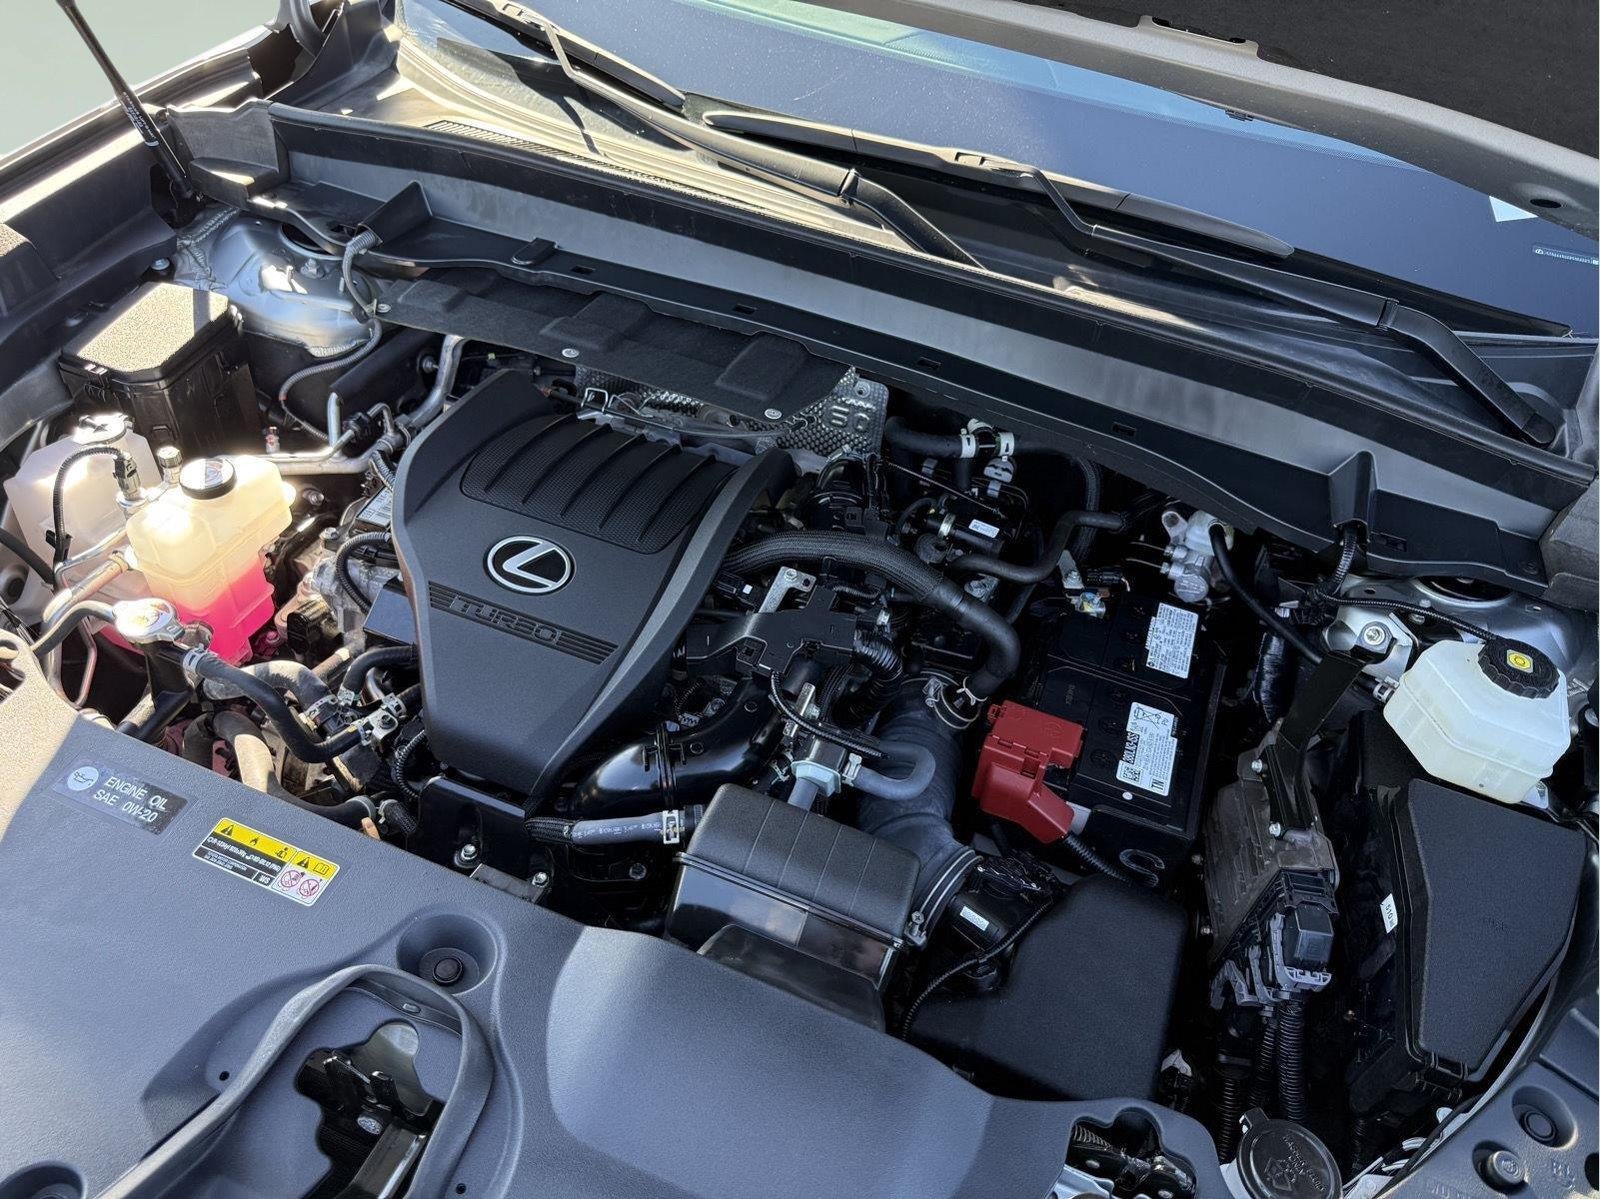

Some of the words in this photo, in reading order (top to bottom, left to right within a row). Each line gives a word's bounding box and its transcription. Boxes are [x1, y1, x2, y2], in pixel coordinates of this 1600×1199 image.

[450, 594, 562, 646] TURBO
[93, 789, 119, 806] SAE
[122, 801, 159, 823] 0W-20
[104, 776, 148, 800] ENGINE
[148, 795, 169, 812] OIL
